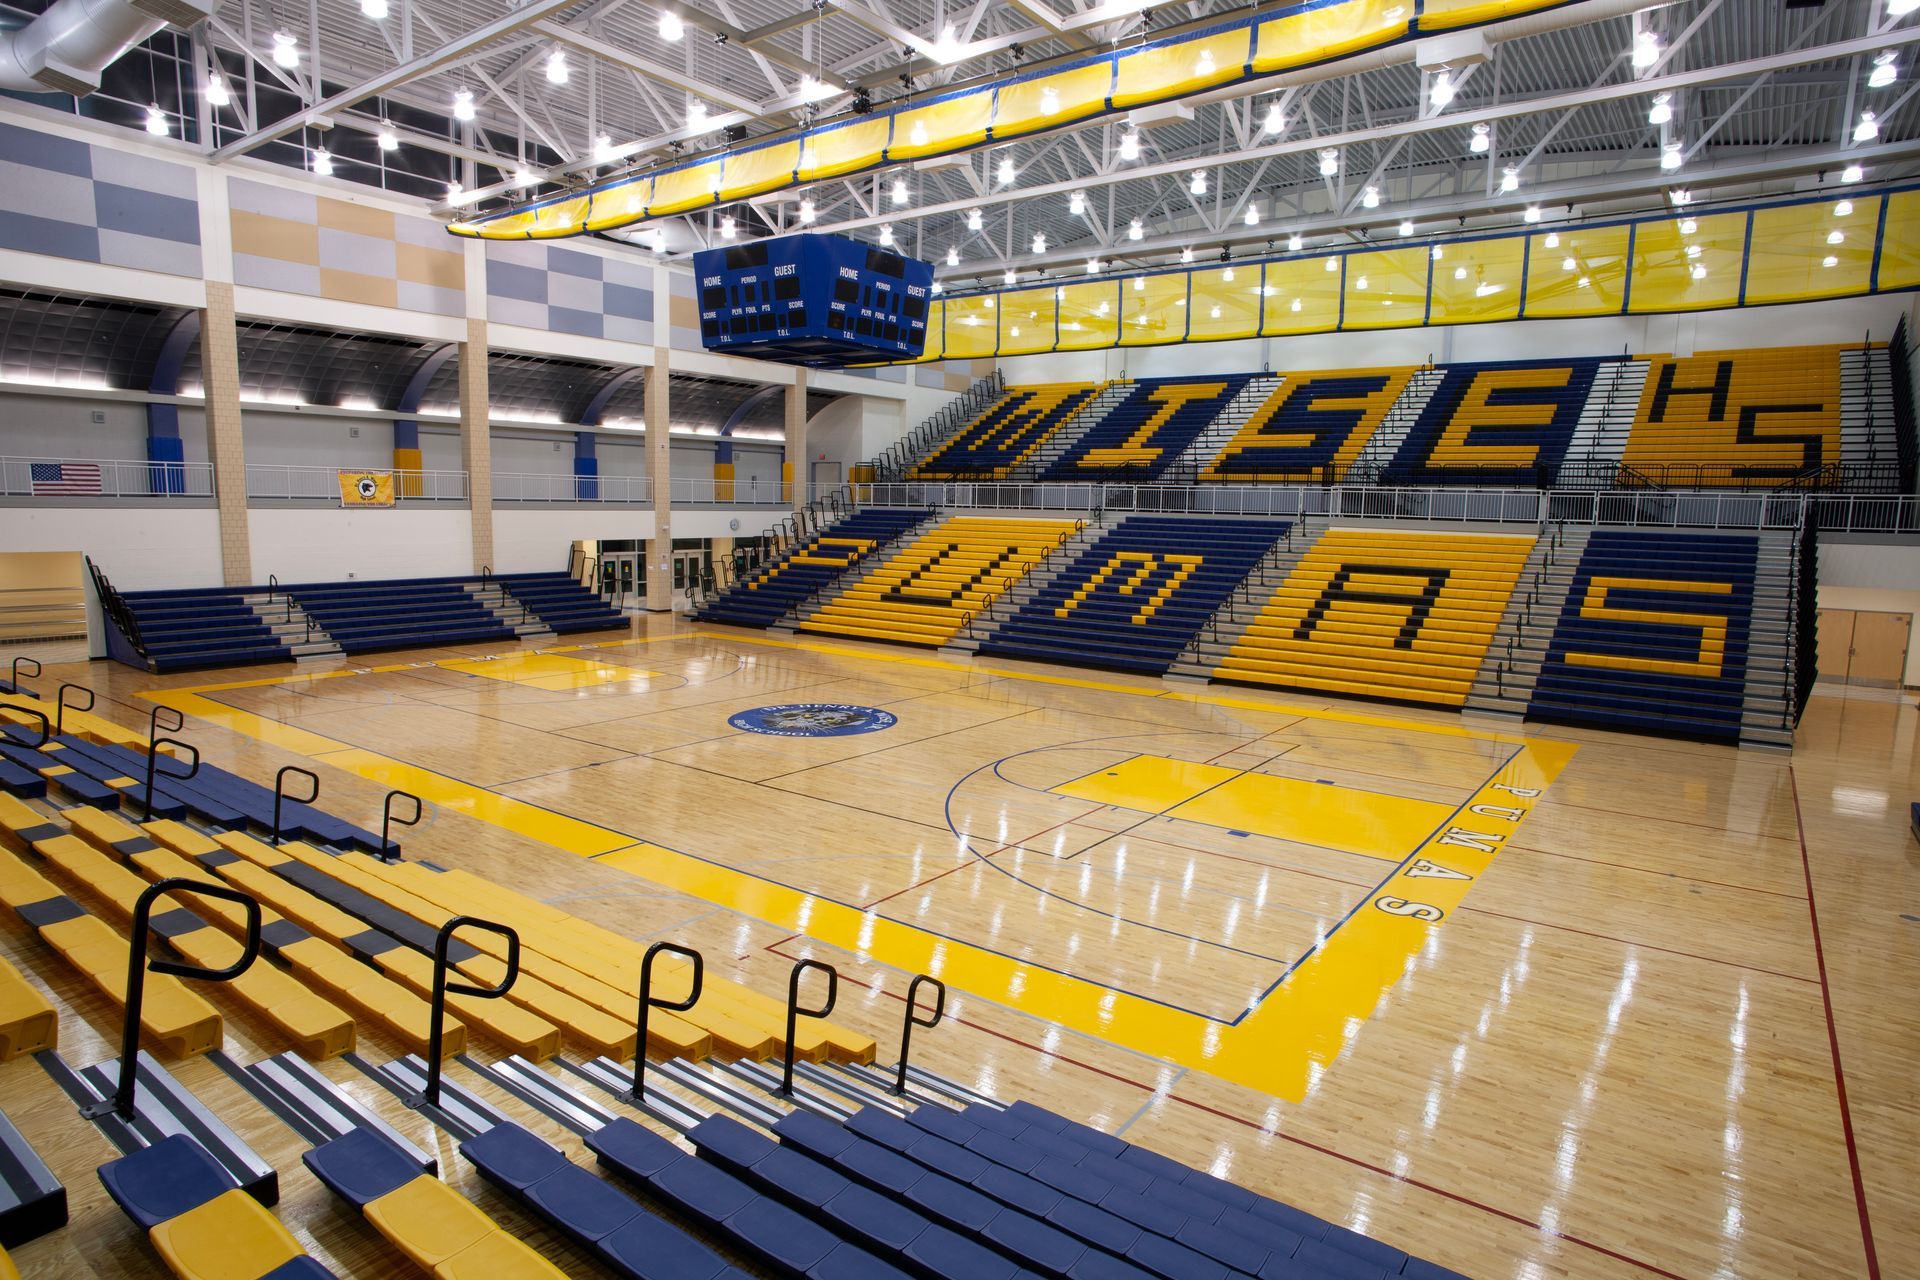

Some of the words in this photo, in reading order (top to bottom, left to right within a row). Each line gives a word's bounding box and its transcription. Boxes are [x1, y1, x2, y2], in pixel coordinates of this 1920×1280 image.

[774, 264, 796, 277] GUEST
[839, 266, 859, 281] HOME
[703, 275, 722, 287] HOME
[740, 275, 757, 284] PERIOD
[875, 281, 891, 291] PERIOD
[907, 284, 926, 298] GUEST
[788, 300, 804, 309] SCORE
[830, 301, 846, 311] SCORE
[731, 308, 743, 316] PLYR
[745, 306, 757, 314] FOUL
[761, 304, 771, 312] PTS
[703, 311, 717, 320] SCORE
[860, 308, 872, 317] PLYR
[874, 311, 885, 321] FOUL
[888, 315, 897, 323] PTS
[911, 320, 924, 329] SCORE
[777, 329, 791, 337] T.O.L.
[843, 331, 855, 340] T.O.L.
[720, 335, 732, 343] T.O.L.
[1648, 361, 1824, 479] HS
[748, 537, 1734, 678] PUMAS
[749, 728, 814, 737] SCHOOL
[1374, 783, 1542, 922] PUMAS
